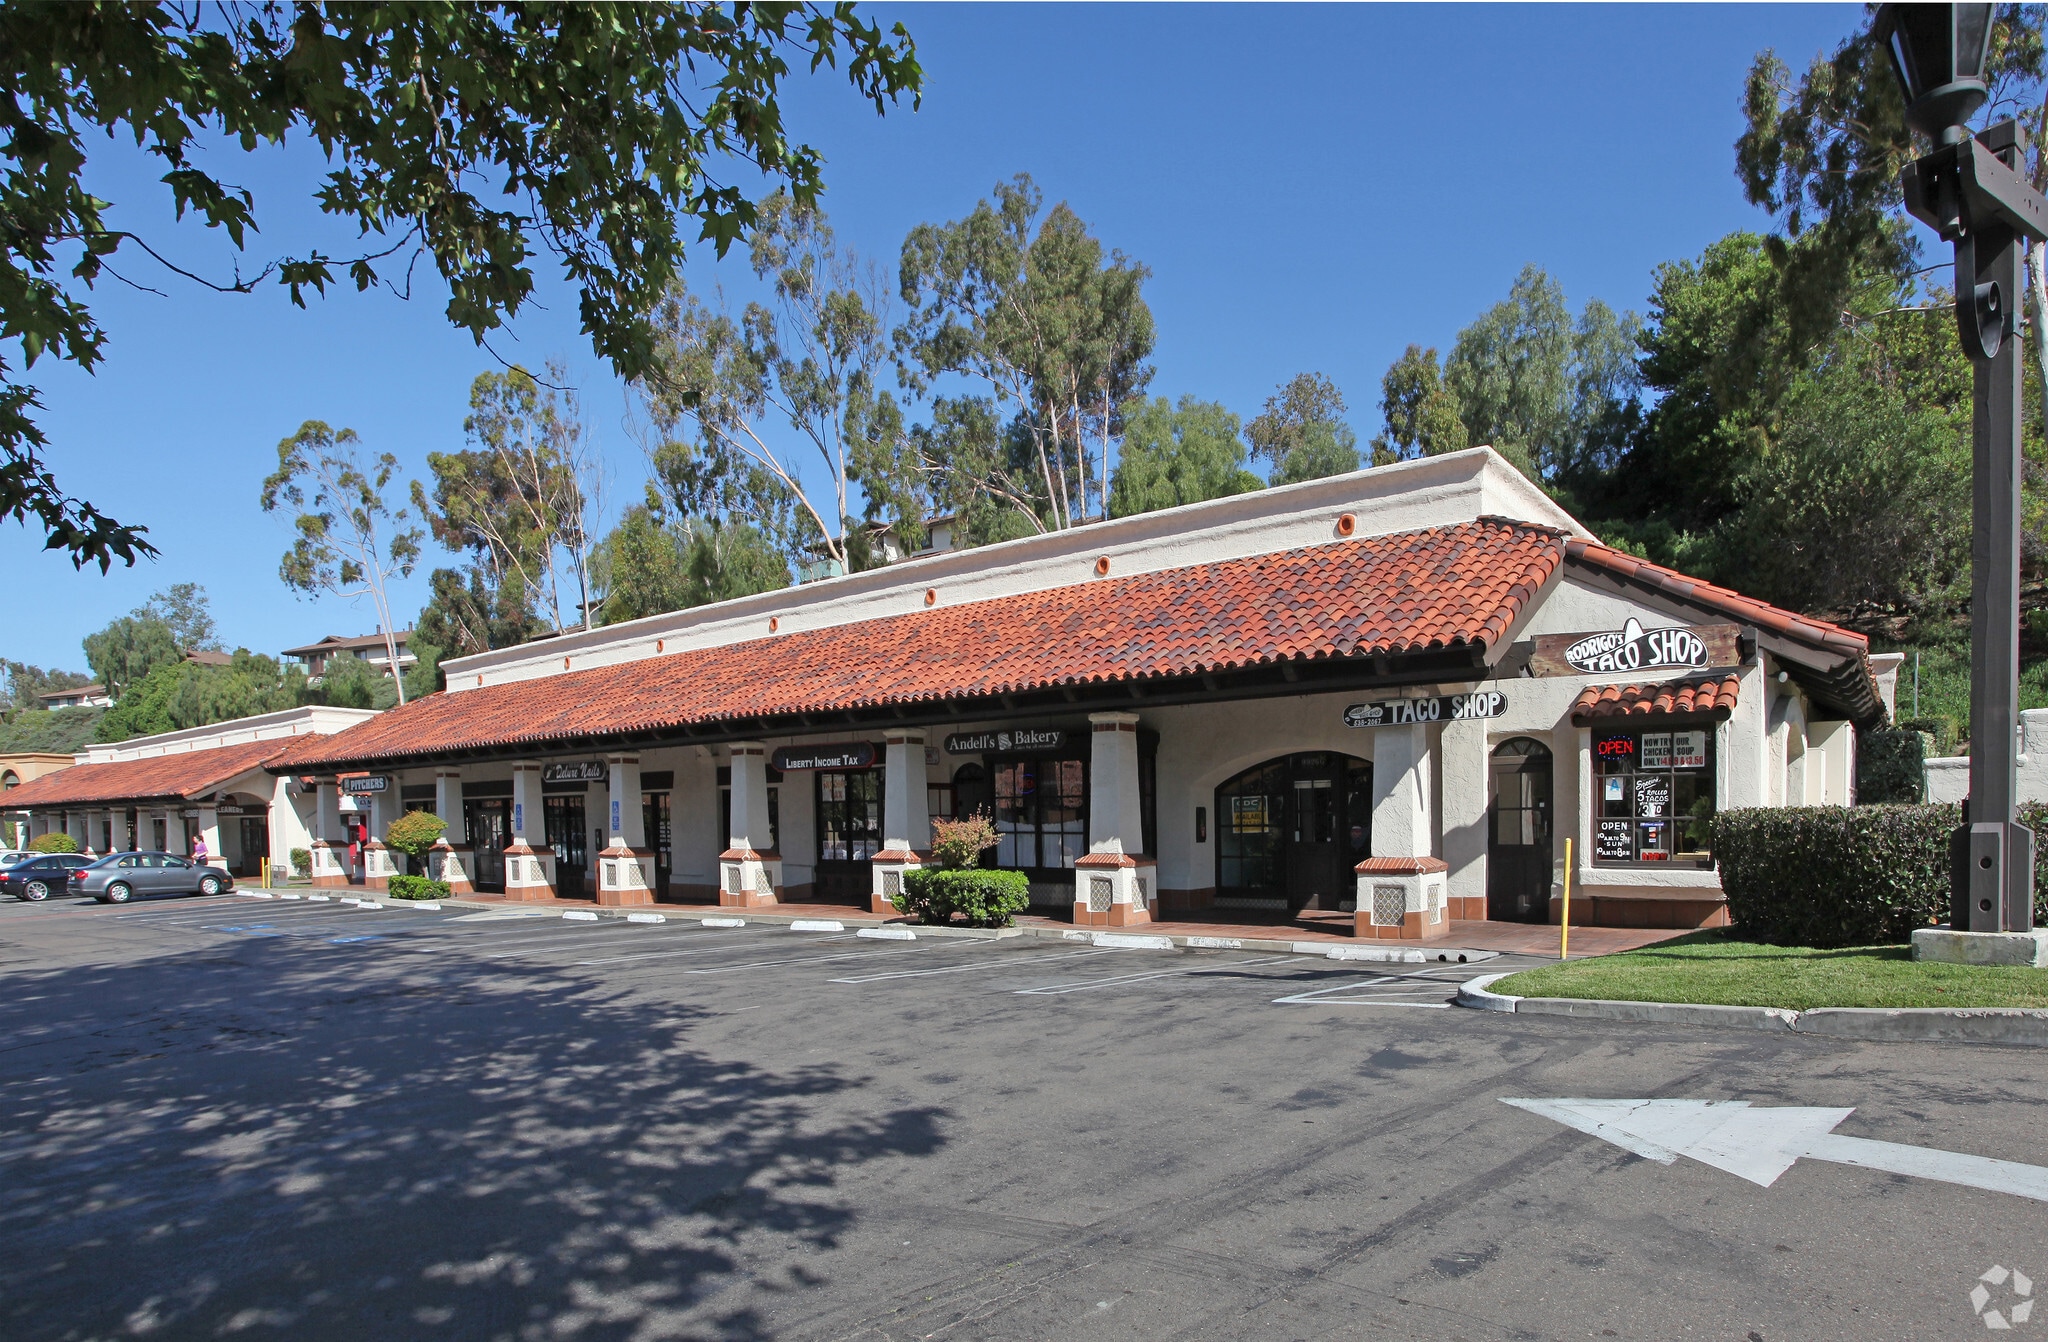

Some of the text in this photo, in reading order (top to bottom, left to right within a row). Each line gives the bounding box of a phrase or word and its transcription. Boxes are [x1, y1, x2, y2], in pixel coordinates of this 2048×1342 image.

[1565, 633, 1624, 662] RODRIGO'S
[1583, 630, 1703, 671] TACO SHOP
[1385, 698, 1440, 723] TACO
[1452, 692, 1501, 719] SHOP
[949, 730, 1060, 751] Andell's Bakery
[1644, 738, 1659, 747] NOW
[1676, 737, 1689, 746] OUR
[1598, 740, 1633, 755] OPEN
[1643, 746, 1695, 756] CHICKEN SOUP
[842, 754, 858, 766] TAX
[1643, 757, 1660, 766] ONLY
[580, 762, 600, 778] Nails
[350, 777, 384, 791] PITCHERS
[1610, 778, 1620, 791] A
[1637, 790, 1645, 802] 5
[1601, 821, 1628, 831] OPEN
[1616, 847, 1623, 857] 8
